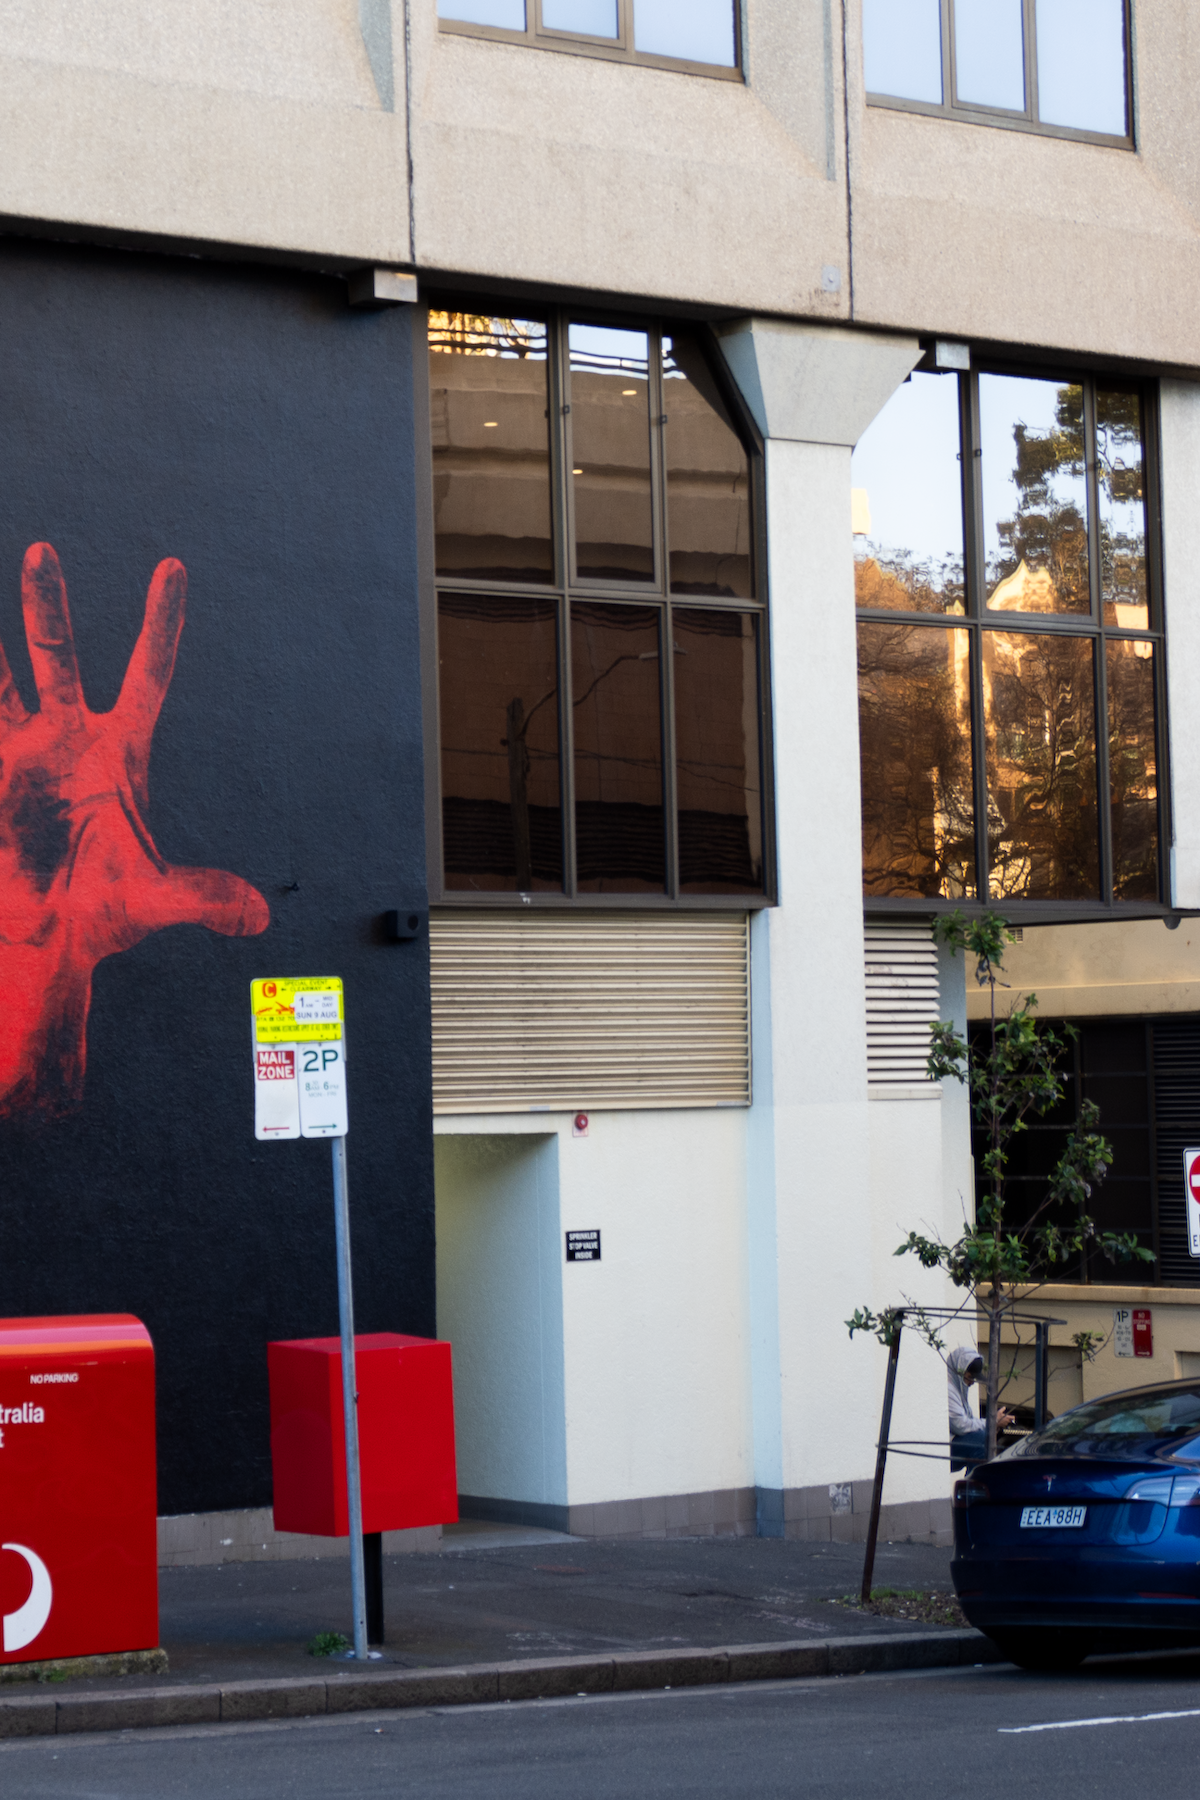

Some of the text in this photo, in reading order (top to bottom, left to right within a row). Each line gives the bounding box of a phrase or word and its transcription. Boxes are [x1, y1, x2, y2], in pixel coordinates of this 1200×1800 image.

[259, 1052, 290, 1065] MAIL
[302, 1049, 338, 1072] 2P
[258, 1066, 294, 1079] ZONE
[1117, 1310, 1129, 1322] 1P
[30, 1372, 79, 1384] NO PARKING
